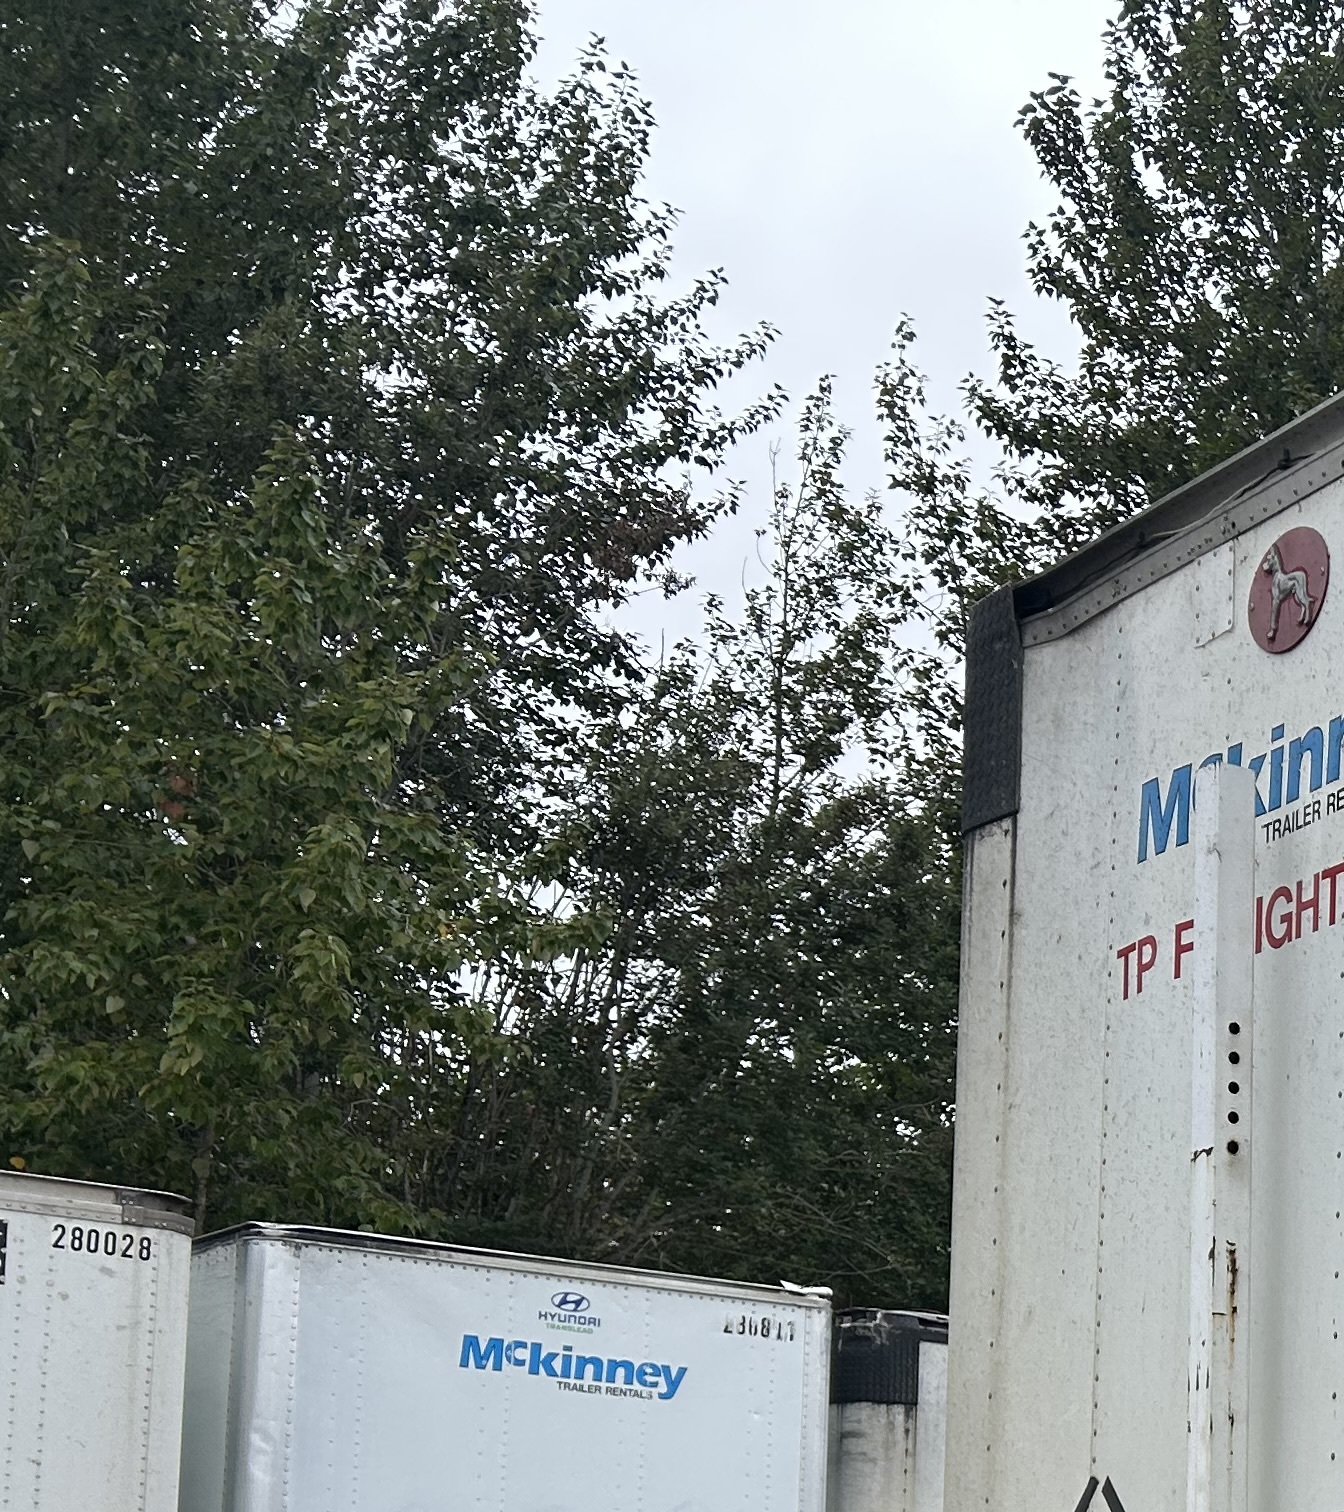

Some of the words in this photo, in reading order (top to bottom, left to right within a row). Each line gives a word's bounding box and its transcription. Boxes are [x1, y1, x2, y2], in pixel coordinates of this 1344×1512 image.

[1262, 800, 1321, 844] TRAILER
[1117, 934, 1158, 1001] TP
[52, 1223, 152, 1261] 280028
[538, 1310, 601, 1327] HYUNDAI
[556, 1380, 602, 1395] TRAILER
[605, 1386, 653, 1400] RENTALS
